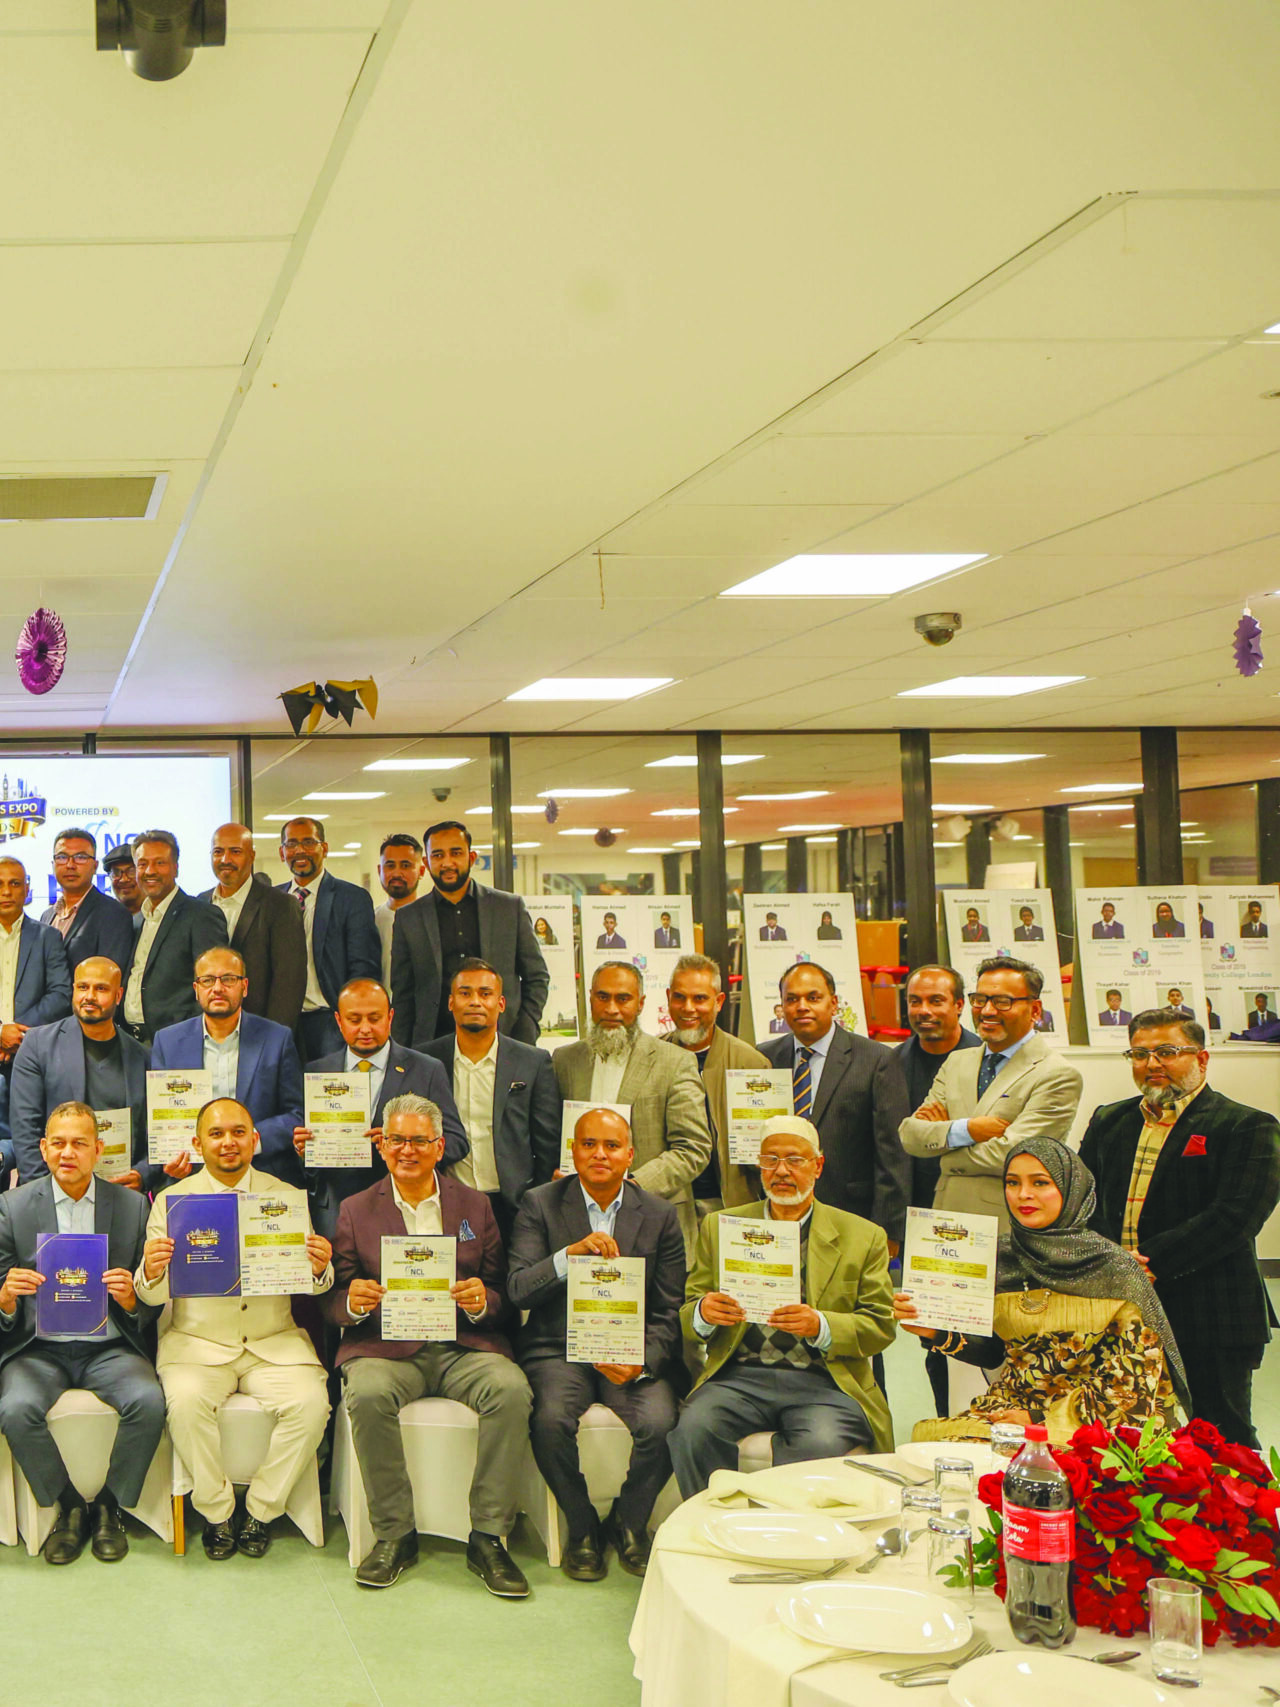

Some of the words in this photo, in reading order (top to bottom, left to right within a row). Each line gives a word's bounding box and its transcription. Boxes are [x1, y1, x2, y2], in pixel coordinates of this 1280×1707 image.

[8, 803, 38, 814] EXPO
[55, 808, 100, 816] POWERED
[102, 807, 114, 816] BY
[329, 1102, 343, 1110] NCL
[266, 1223, 281, 1231] NCL
[749, 1251, 766, 1260] NCL
[941, 1247, 960, 1258] NCL
[410, 1268, 425, 1276] NCL
[597, 1289, 613, 1298] NCL
